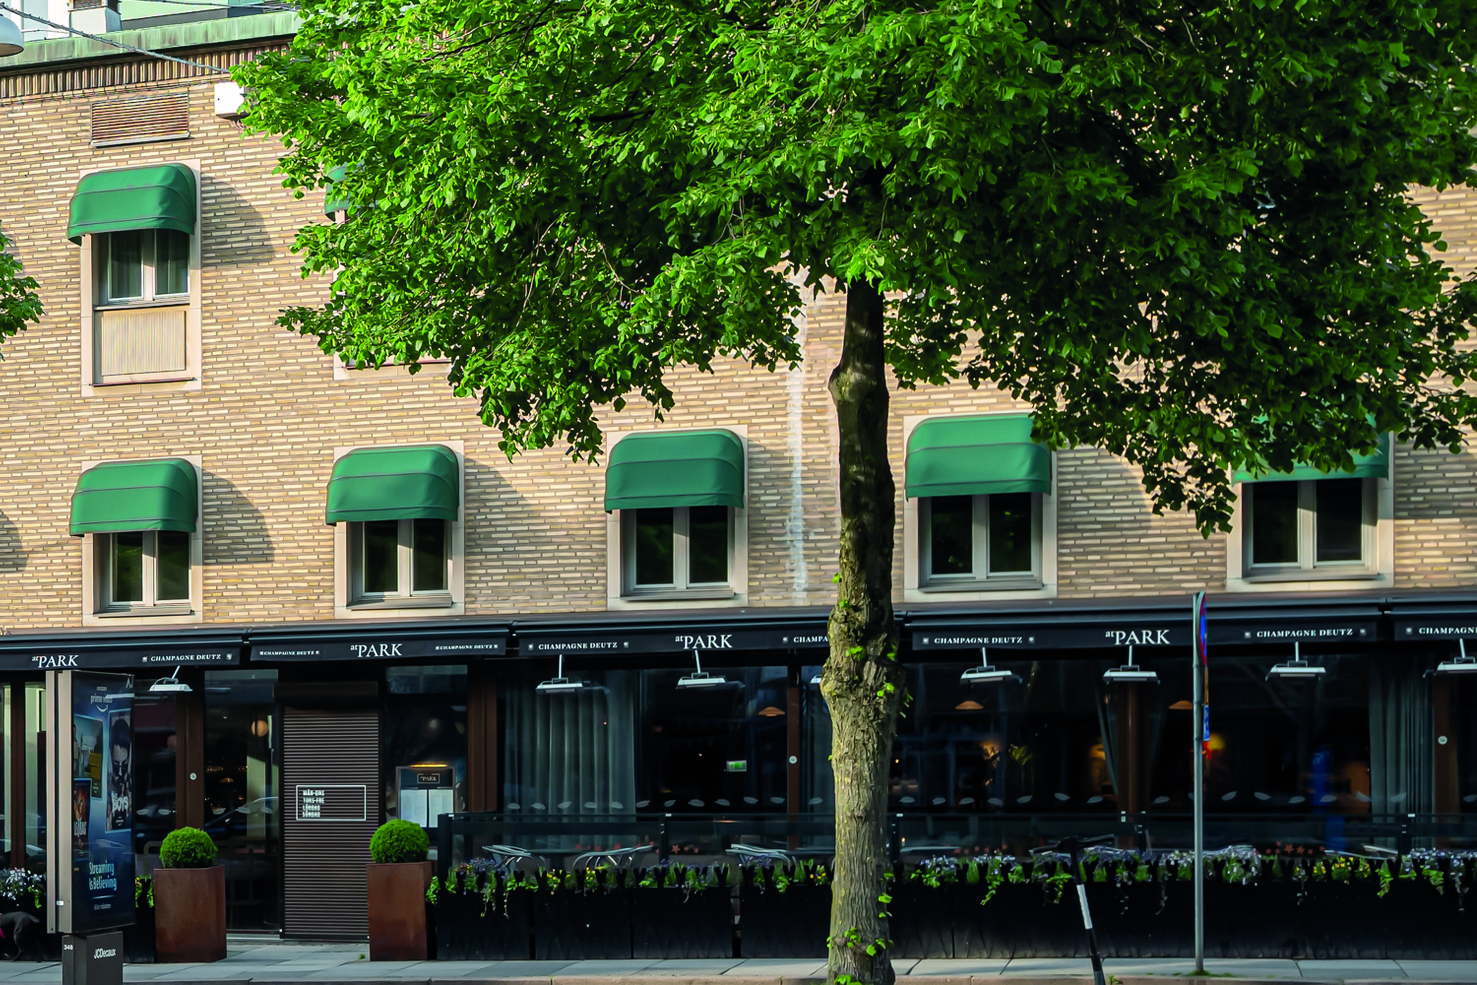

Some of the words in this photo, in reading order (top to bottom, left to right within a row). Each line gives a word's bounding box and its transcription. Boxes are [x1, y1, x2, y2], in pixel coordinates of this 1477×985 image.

[1319, 628, 1353, 636] DEUTZ
[112, 796, 129, 813] BOYS
[89, 860, 114, 876] Streaming
[93, 875, 117, 891] Believing
[93, 947, 116, 959] JCDecaux
